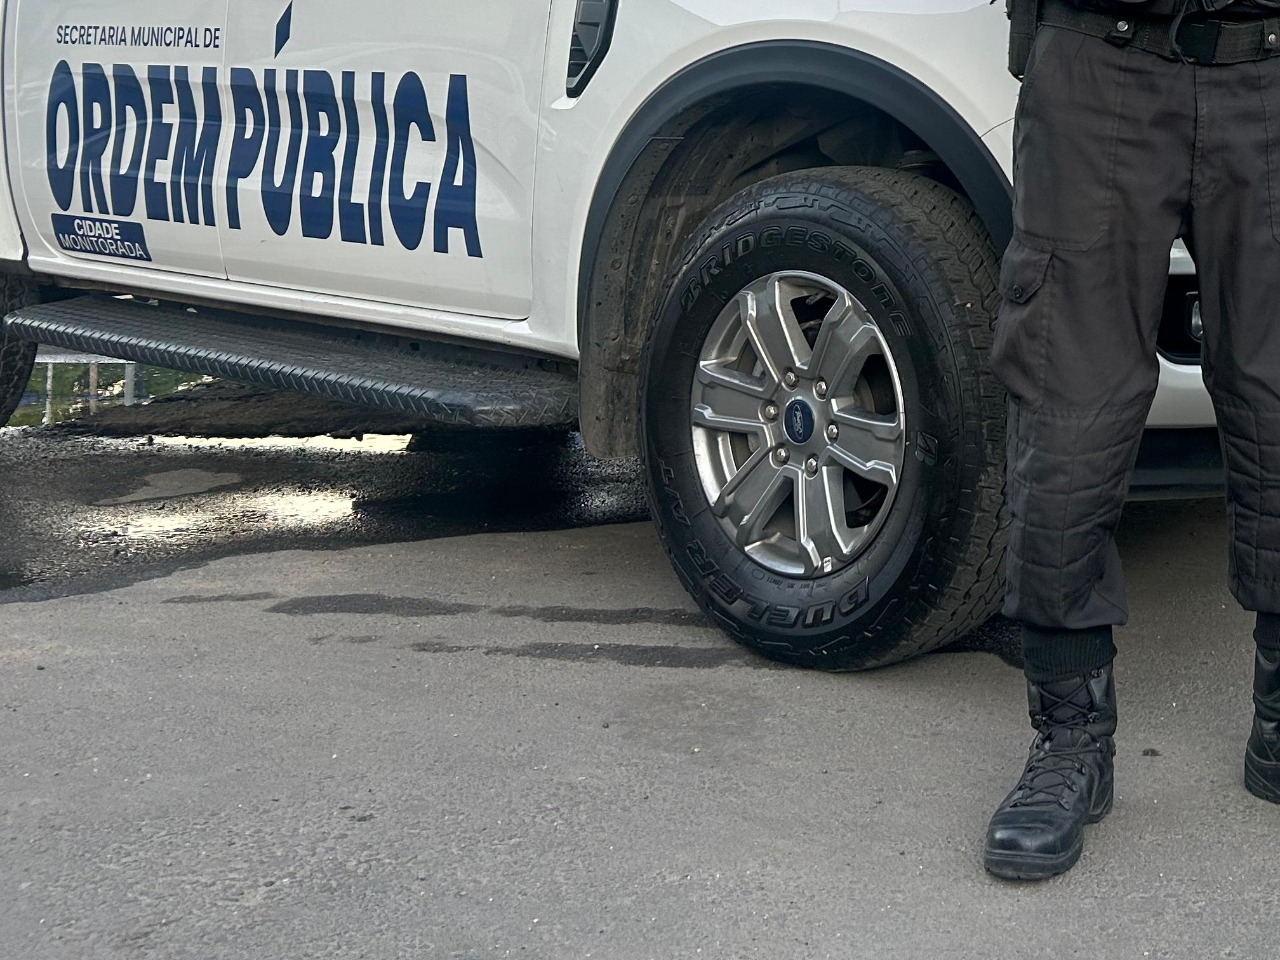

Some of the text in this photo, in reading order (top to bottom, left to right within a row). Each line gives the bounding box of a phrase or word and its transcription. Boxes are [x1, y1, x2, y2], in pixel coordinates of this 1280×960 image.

[56, 25, 222, 49] SECRETARIA MUNICIPAL DE
[46, 0, 484, 259] ORDEM PÚBLICA
[58, 233, 148, 259] MONITORADA
[73, 218, 122, 240] CIDADE
[679, 224, 914, 338] BRIDGESTONE
[686, 539, 870, 628] DUELER
